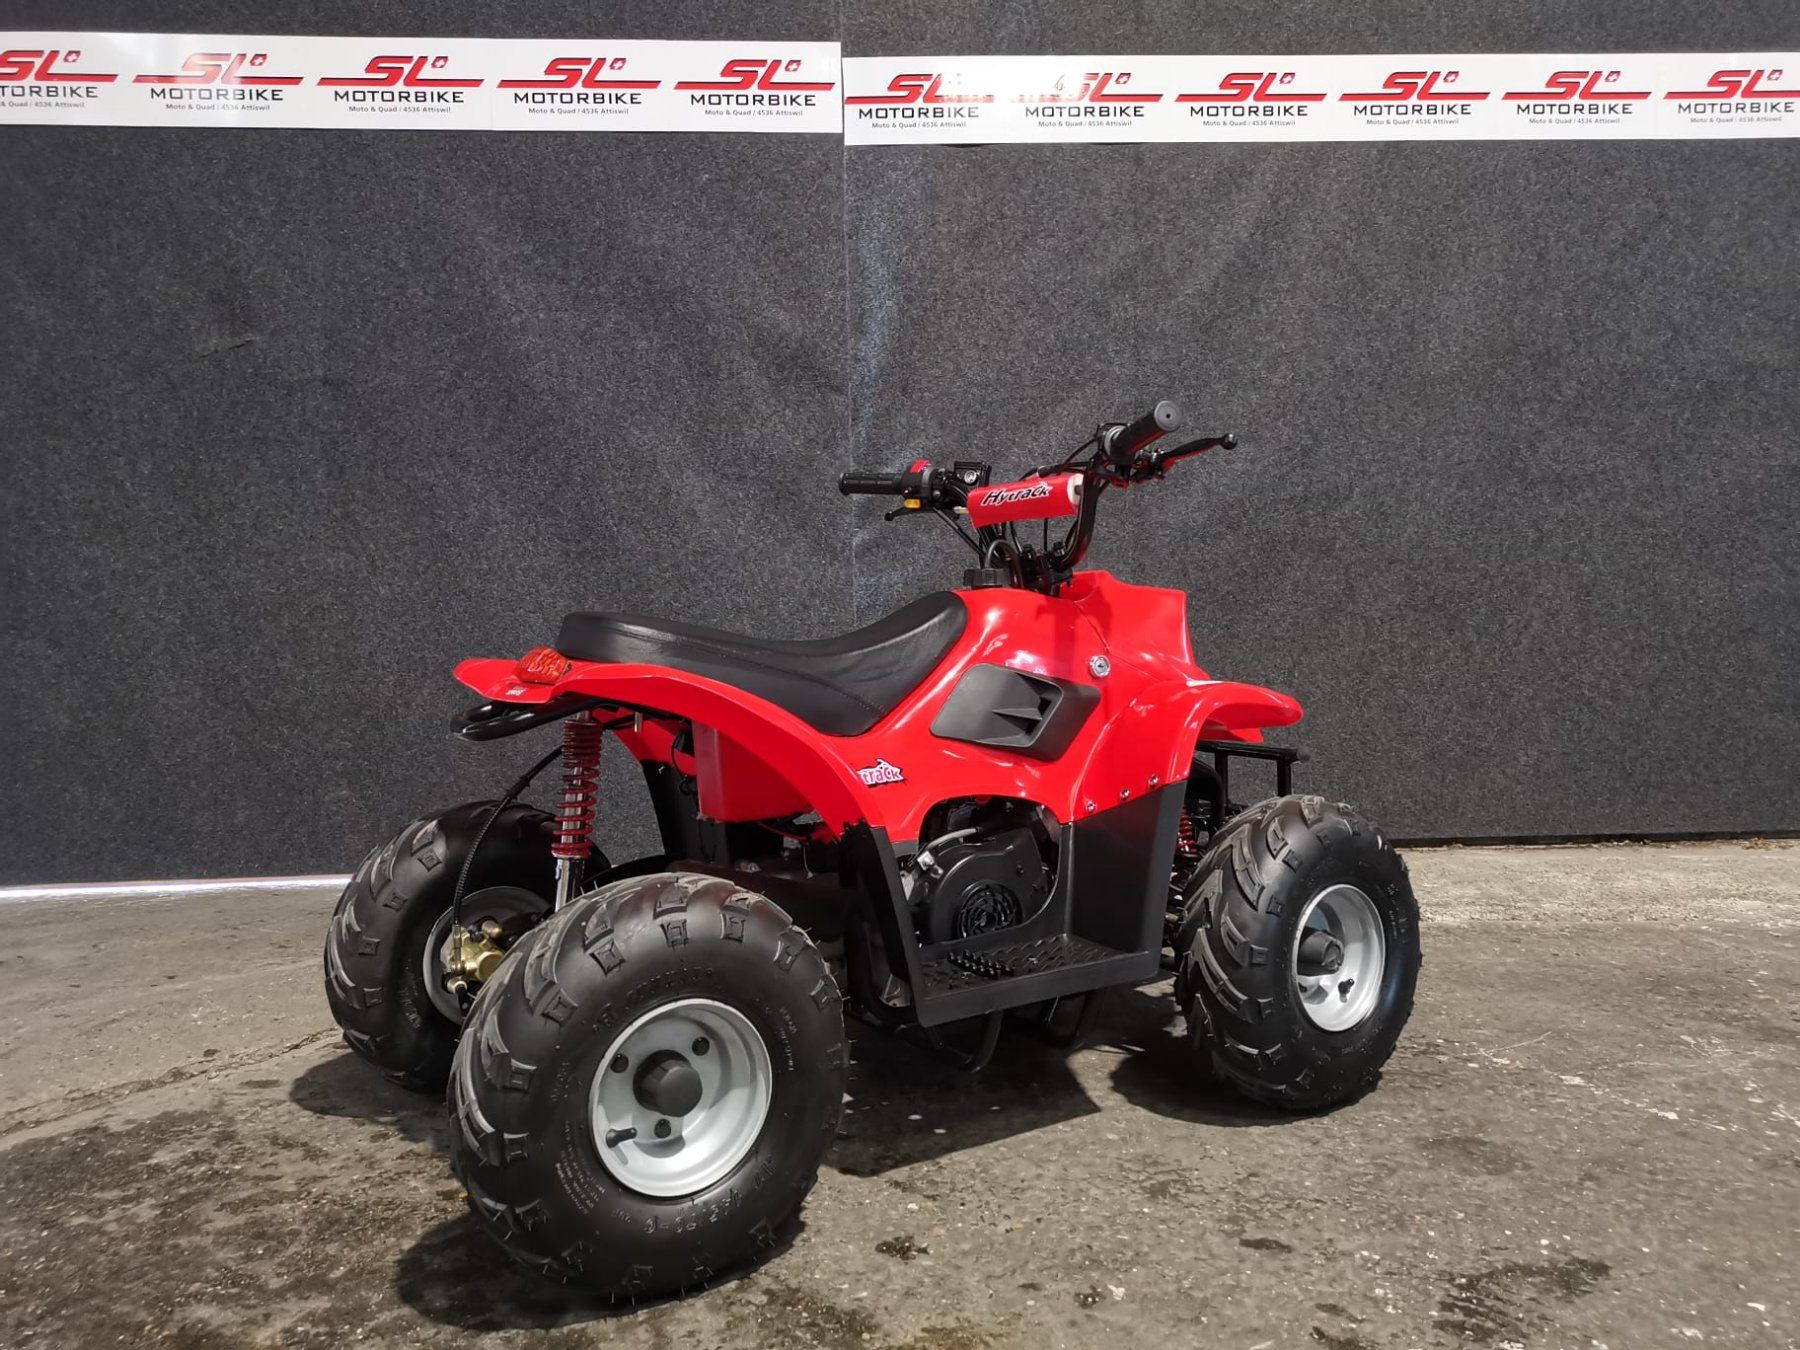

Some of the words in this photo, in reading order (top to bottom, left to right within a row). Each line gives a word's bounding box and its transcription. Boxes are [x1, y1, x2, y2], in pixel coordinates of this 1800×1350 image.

[0, 85, 99, 99] TORBIKE
[150, 87, 284, 101] MOTORBIKE
[334, 90, 465, 103] MOTORBIKE
[514, 92, 643, 105] MOTORBIKE
[691, 94, 817, 107] MOTORBIKE
[858, 107, 980, 120] MOTORBIKE
[1025, 106, 1146, 118] MOTORBIKE
[1190, 105, 1309, 117] MOTORBIKE
[1354, 104, 1472, 116] MOTORBIKE
[1516, 103, 1634, 115] MOTORBIKE
[1678, 102, 1796, 114] MOTORBIKE
[982, 484, 1050, 505] Hytrack
